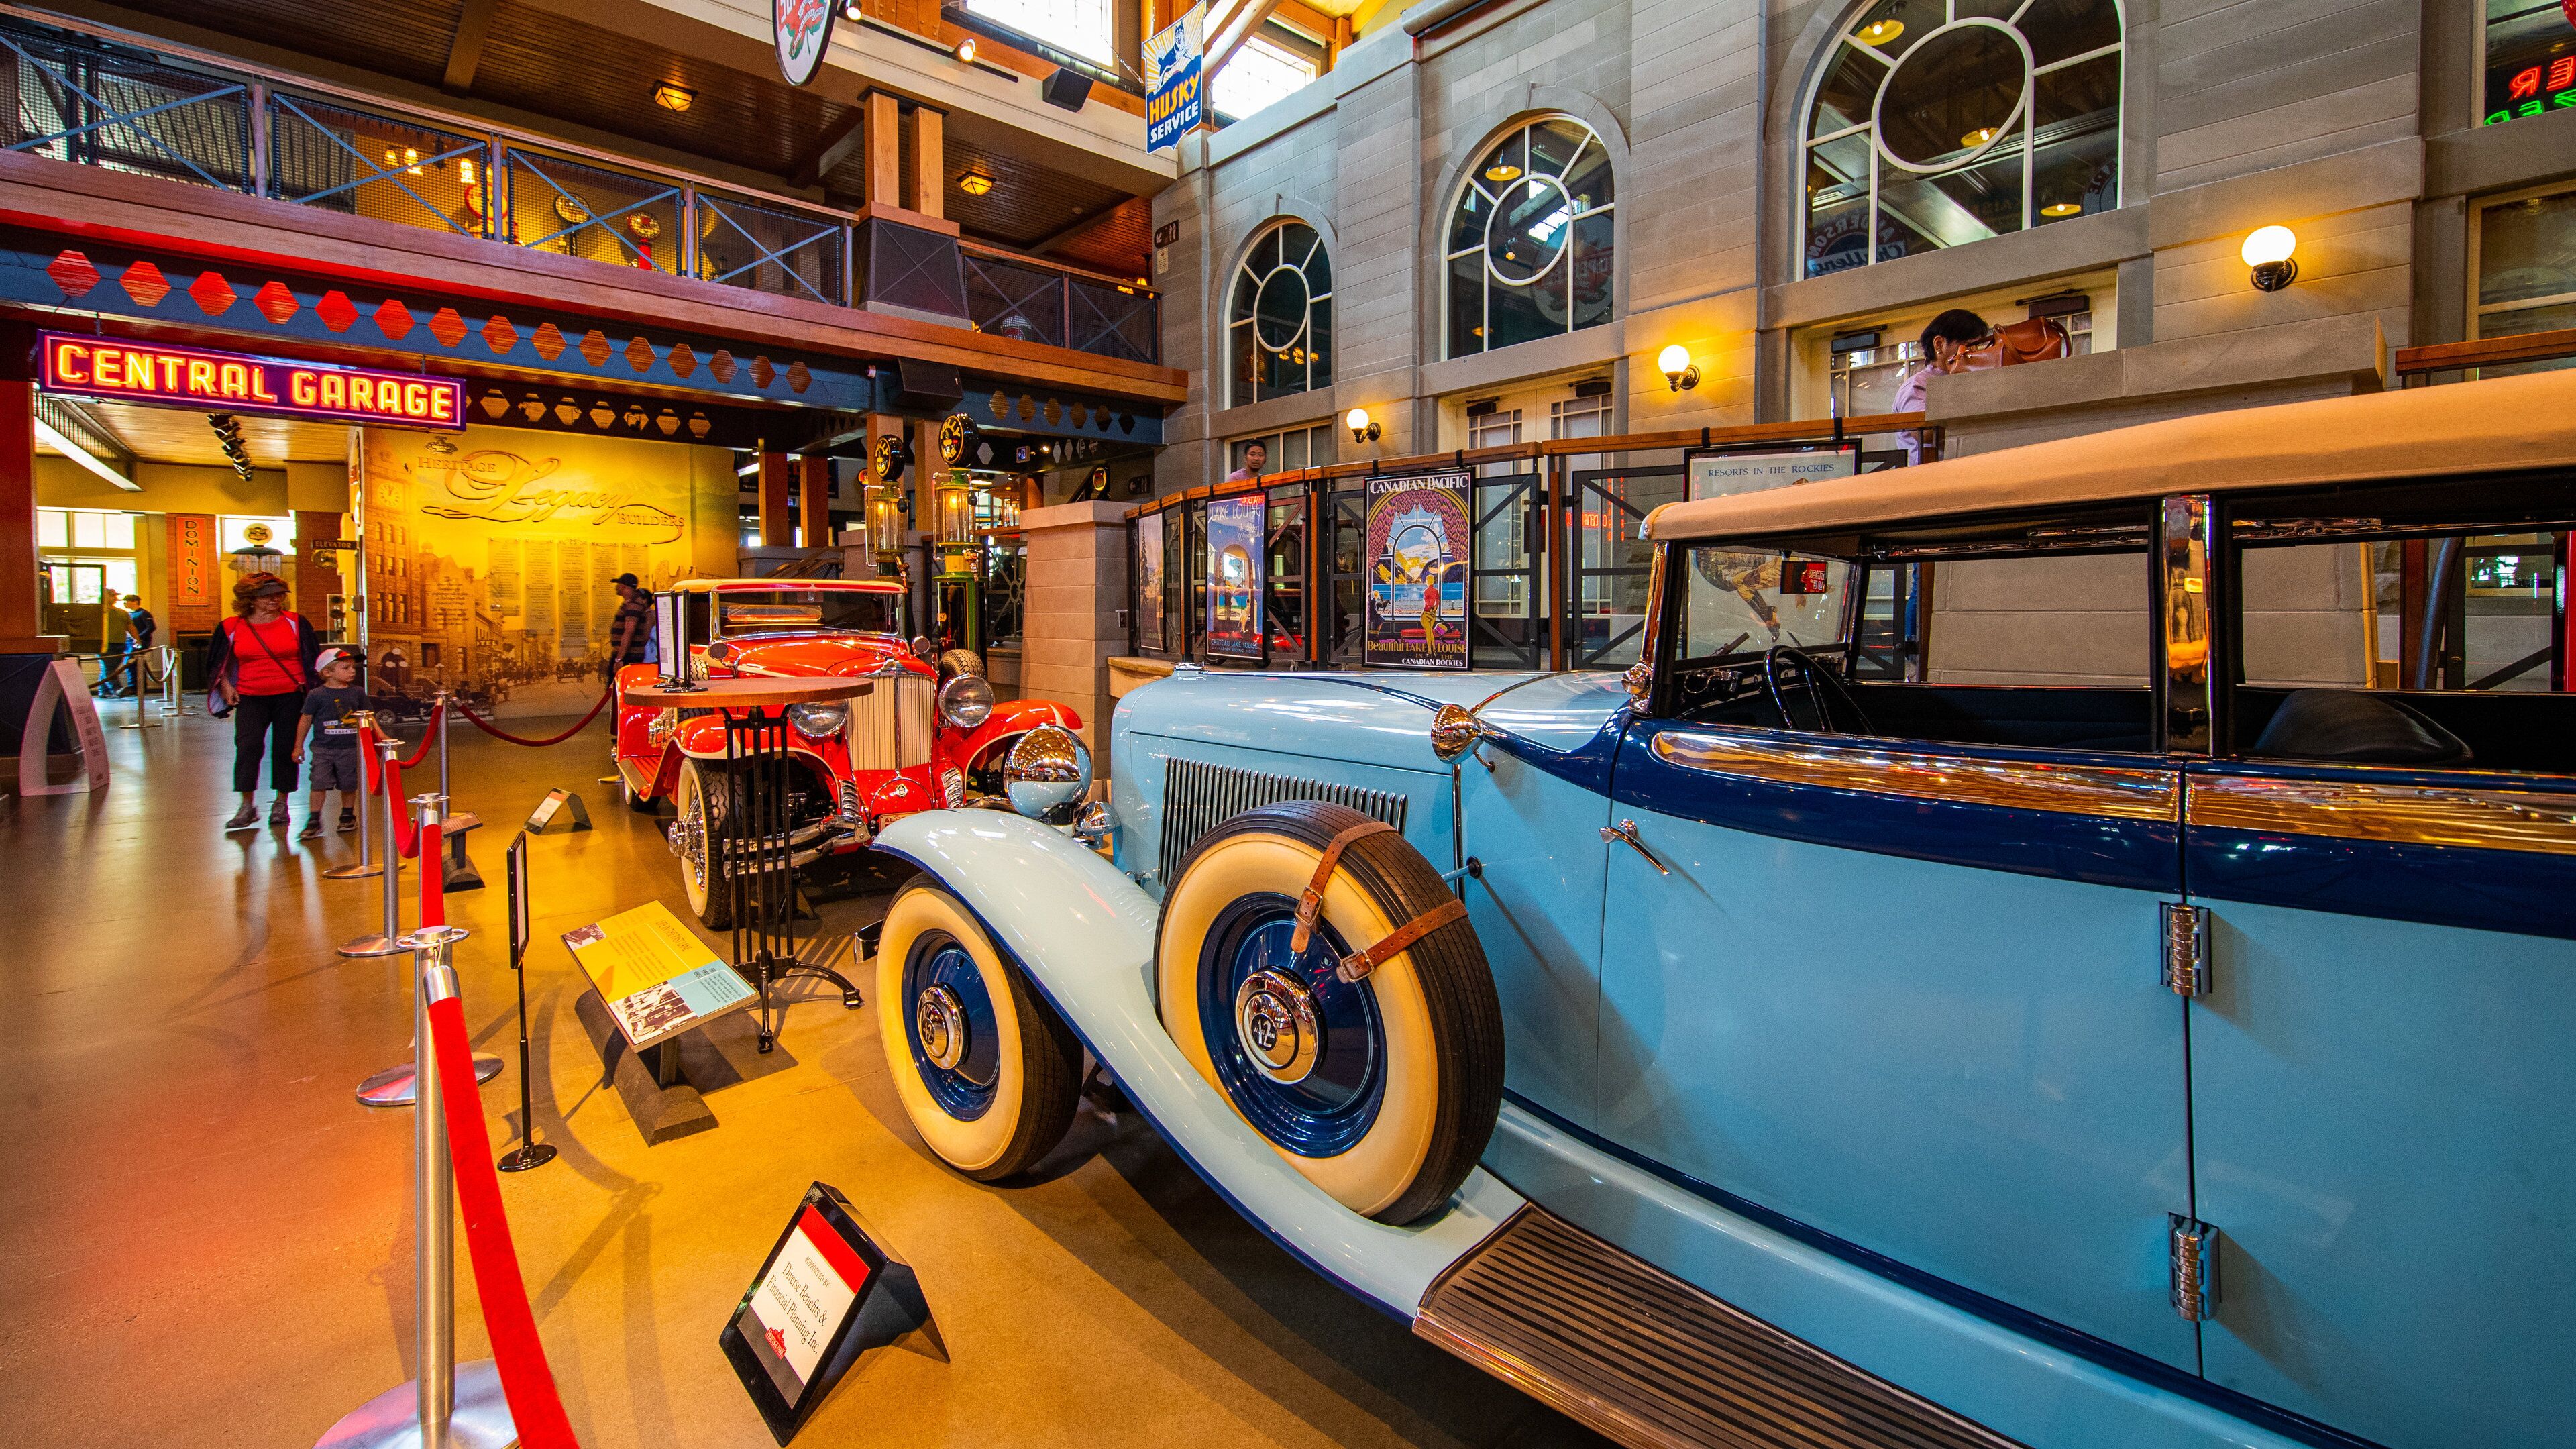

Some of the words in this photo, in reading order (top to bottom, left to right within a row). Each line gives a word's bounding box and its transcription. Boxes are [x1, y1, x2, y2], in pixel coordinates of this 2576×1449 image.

[1149, 71, 1201, 126] HUSKY
[1150, 100, 1199, 144] SERVICE
[58, 343, 278, 403] CENTRAL
[290, 370, 455, 419] GARAGE
[417, 456, 496, 473] HERITAGE
[1708, 468, 1748, 477] RESORTS
[1753, 467, 1764, 475] IN
[1768, 466, 1786, 474] THE
[1792, 464, 1835, 474] ROCKIES
[421, 450, 634, 525] Legacy
[1369, 479, 1426, 494] CANADIAN
[1427, 475, 1468, 490] PACIFIC
[617, 512, 685, 527] BUILDERS
[1212, 504, 1229, 521] LAKE
[1232, 502, 1261, 519] LOUISE
[315, 541, 352, 549] ELEVATOR
[184, 520, 200, 596] DOMINION
[1367, 640, 1404, 652] Beautiful
[1405, 643, 1427, 653] LAKE
[1437, 643, 1466, 653] LOUISE
[1436, 659, 1464, 667] ROCKIES
[804, 1256, 825, 1283] SUPPORTED
[822, 1279, 830, 1288] BY
[782, 1261, 802, 1292] Diverse
[799, 1284, 820, 1318] Benefits
[818, 1310, 828, 1327] &
[766, 1275, 791, 1311] Financial
[786, 1301, 810, 1344] Planning
[807, 1330, 821, 1355] Inc.
